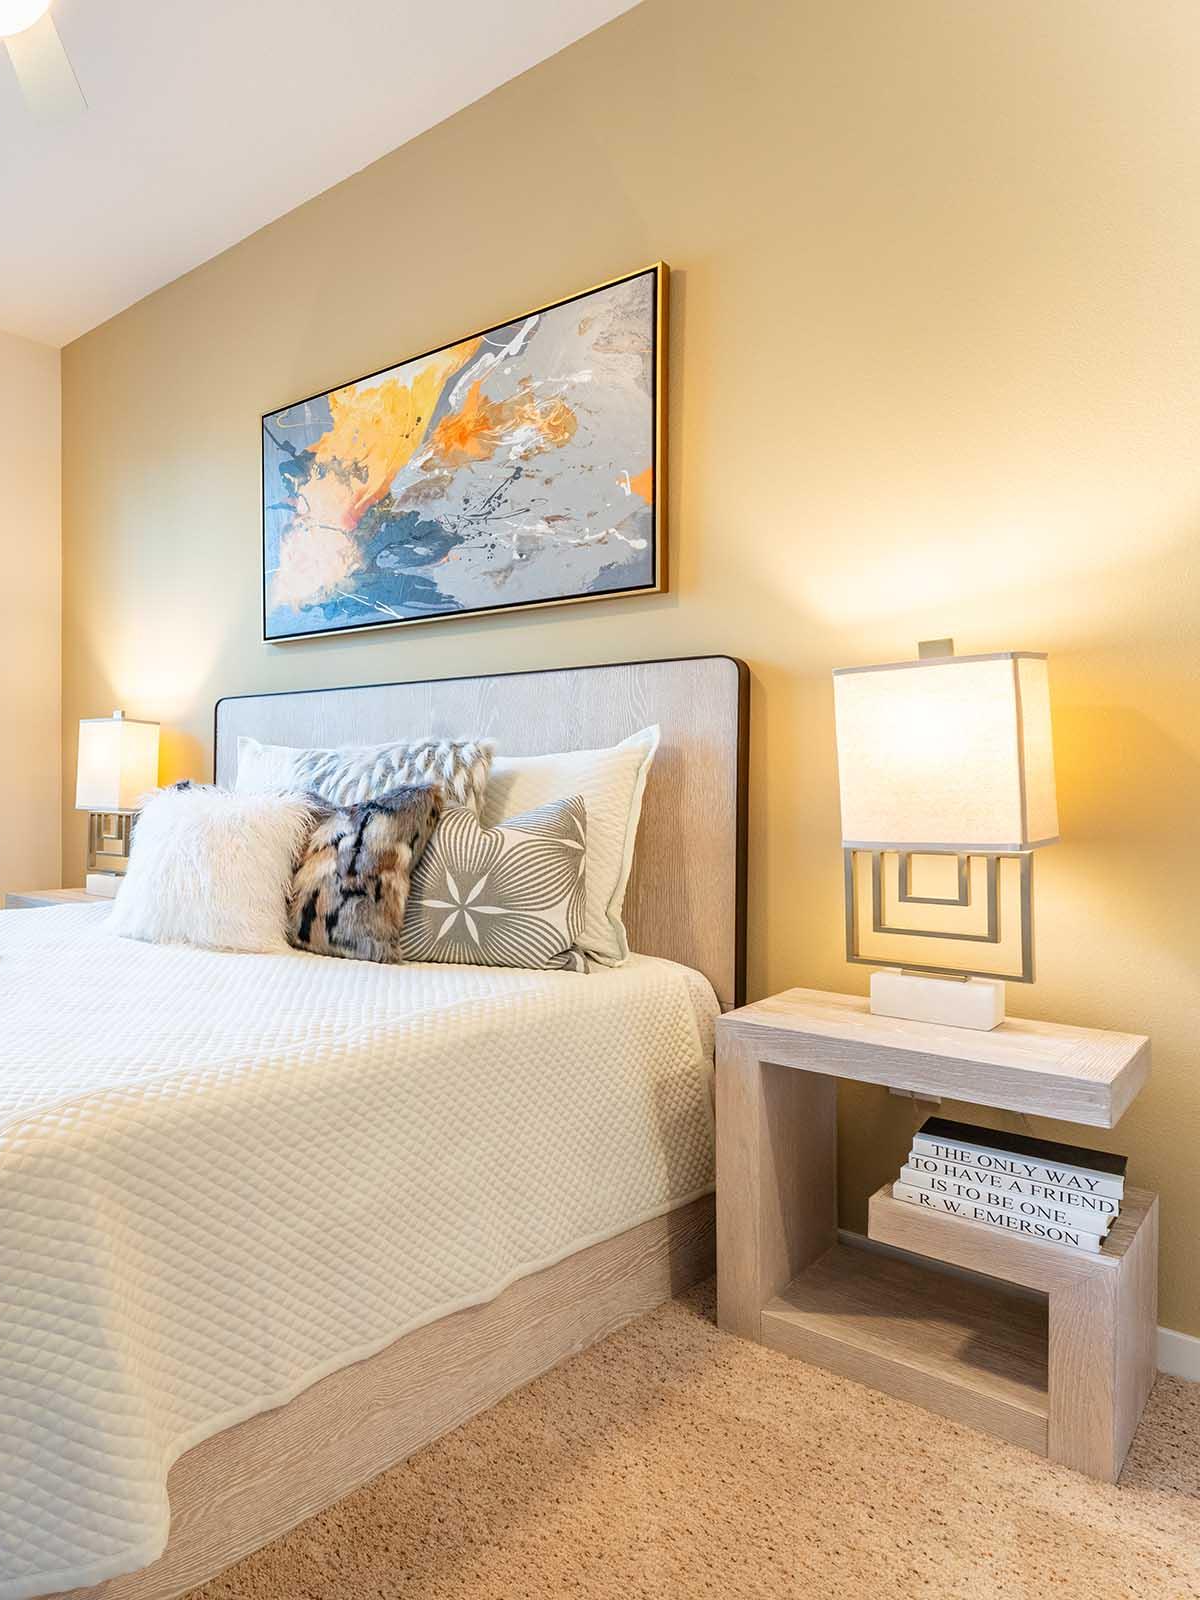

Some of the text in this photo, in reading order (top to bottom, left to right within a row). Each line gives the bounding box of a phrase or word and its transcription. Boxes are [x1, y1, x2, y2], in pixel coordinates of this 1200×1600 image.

[911, 1156, 1115, 1214] TO HAVE A FRIEND
[932, 1144, 1101, 1191] THE ONLY WAY
[919, 1193, 936, 1208] R.
[943, 1200, 966, 1216] W.
[974, 1208, 1080, 1246] EMERSON
[930, 1177, 1072, 1226] IS TO BE ONE.
